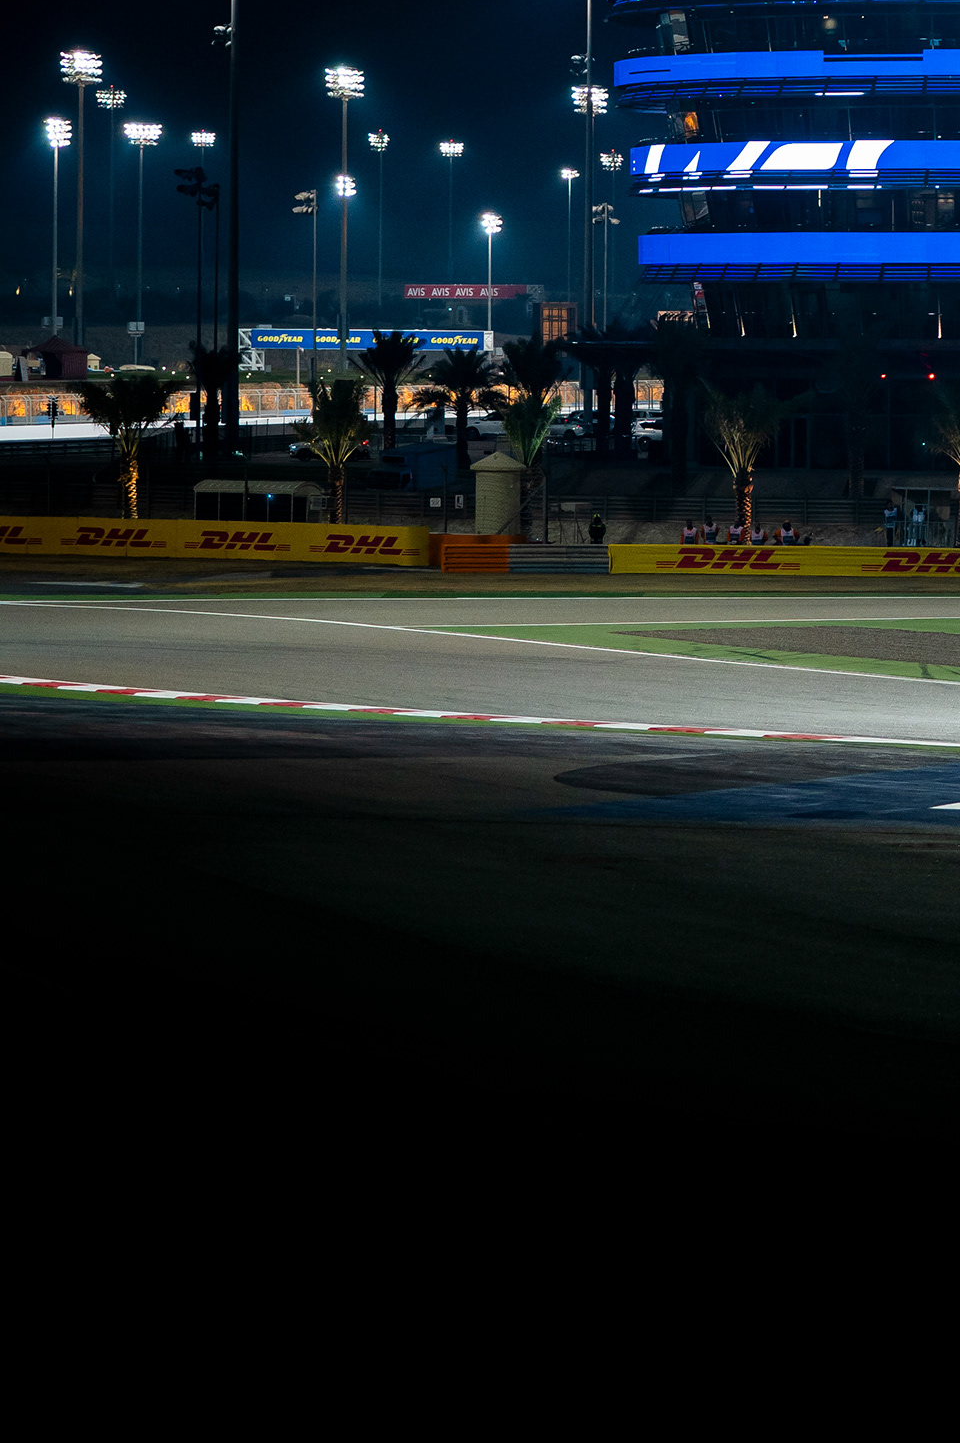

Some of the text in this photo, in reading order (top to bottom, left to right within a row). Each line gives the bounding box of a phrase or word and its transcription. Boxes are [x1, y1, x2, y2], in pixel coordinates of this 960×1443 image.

[407, 287, 426, 296] AVIS
[431, 287, 450, 296] AVIS
[455, 287, 474, 296] AVIS
[257, 333, 303, 344] GOODYEAR
[431, 335, 478, 346] GOODYEAR
[75, 527, 152, 548] DHL
[199, 530, 276, 551] DHL
[324, 534, 402, 556] DHL
[676, 548, 781, 570] DHL
